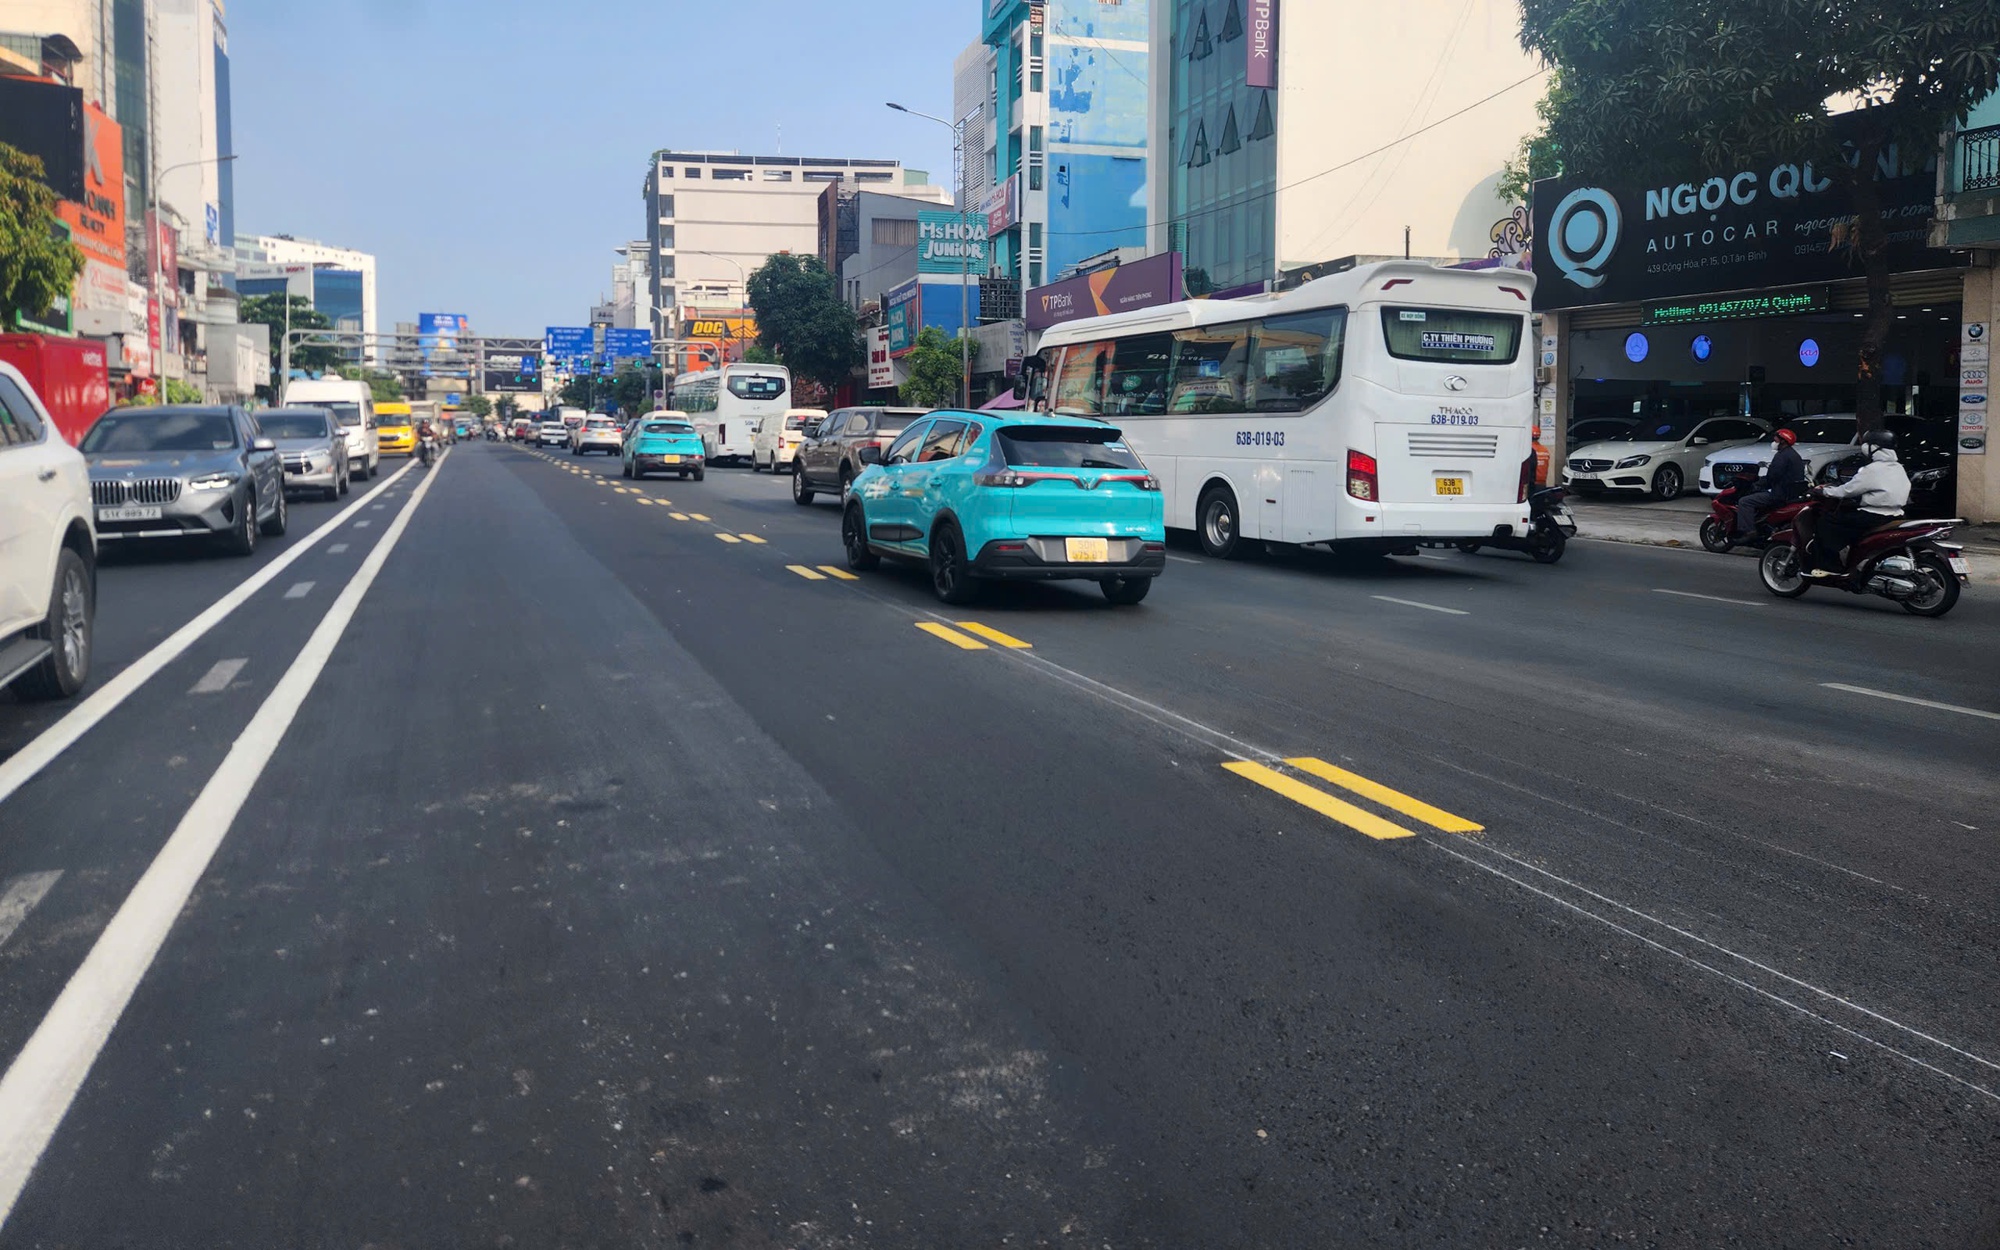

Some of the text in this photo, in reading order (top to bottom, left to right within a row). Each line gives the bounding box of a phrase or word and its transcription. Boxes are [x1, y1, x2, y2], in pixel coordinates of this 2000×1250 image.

[1254, 0, 1270, 58] TPBank
[1645, 171, 1758, 222] NGỌC
[1646, 219, 1778, 254] AUTOCAR
[1647, 262, 1661, 274] 439
[1049, 292, 1073, 310] TPBank
[1654, 293, 1812, 319] Hotline: 0914577074 Quỳnh
[1438, 406, 1473, 415] THACO
[1430, 414, 1479, 426] 63B-019.03
[1443, 478, 1456, 487] 63B
